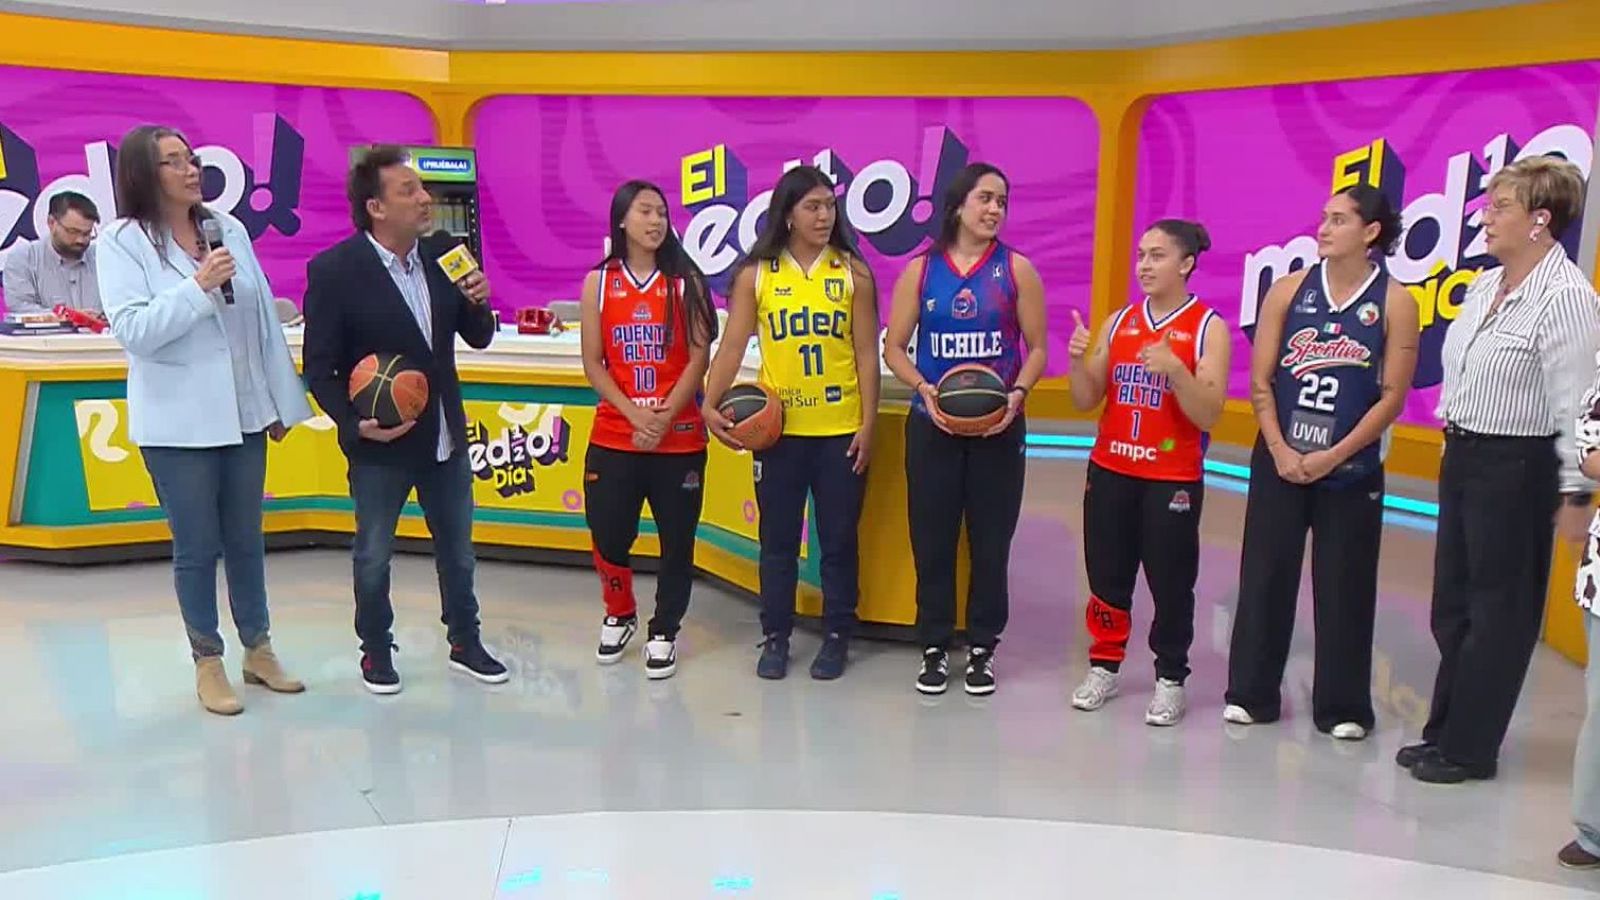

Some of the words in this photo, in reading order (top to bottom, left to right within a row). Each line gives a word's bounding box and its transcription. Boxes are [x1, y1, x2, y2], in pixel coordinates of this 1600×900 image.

[681, 143, 726, 206] El
[768, 306, 847, 342] UdeC
[624, 343, 666, 363] ALTO
[798, 344, 824, 377] 11
[1281, 327, 1371, 367] Sportiva
[634, 367, 657, 393] 10
[1298, 373, 1340, 412] 22
[1118, 383, 1163, 410] ALTO
[1131, 410, 1142, 441] 1
[1292, 421, 1329, 445] UVM
[1110, 440, 1157, 462] cmpc
[494, 465, 527, 489] Día
